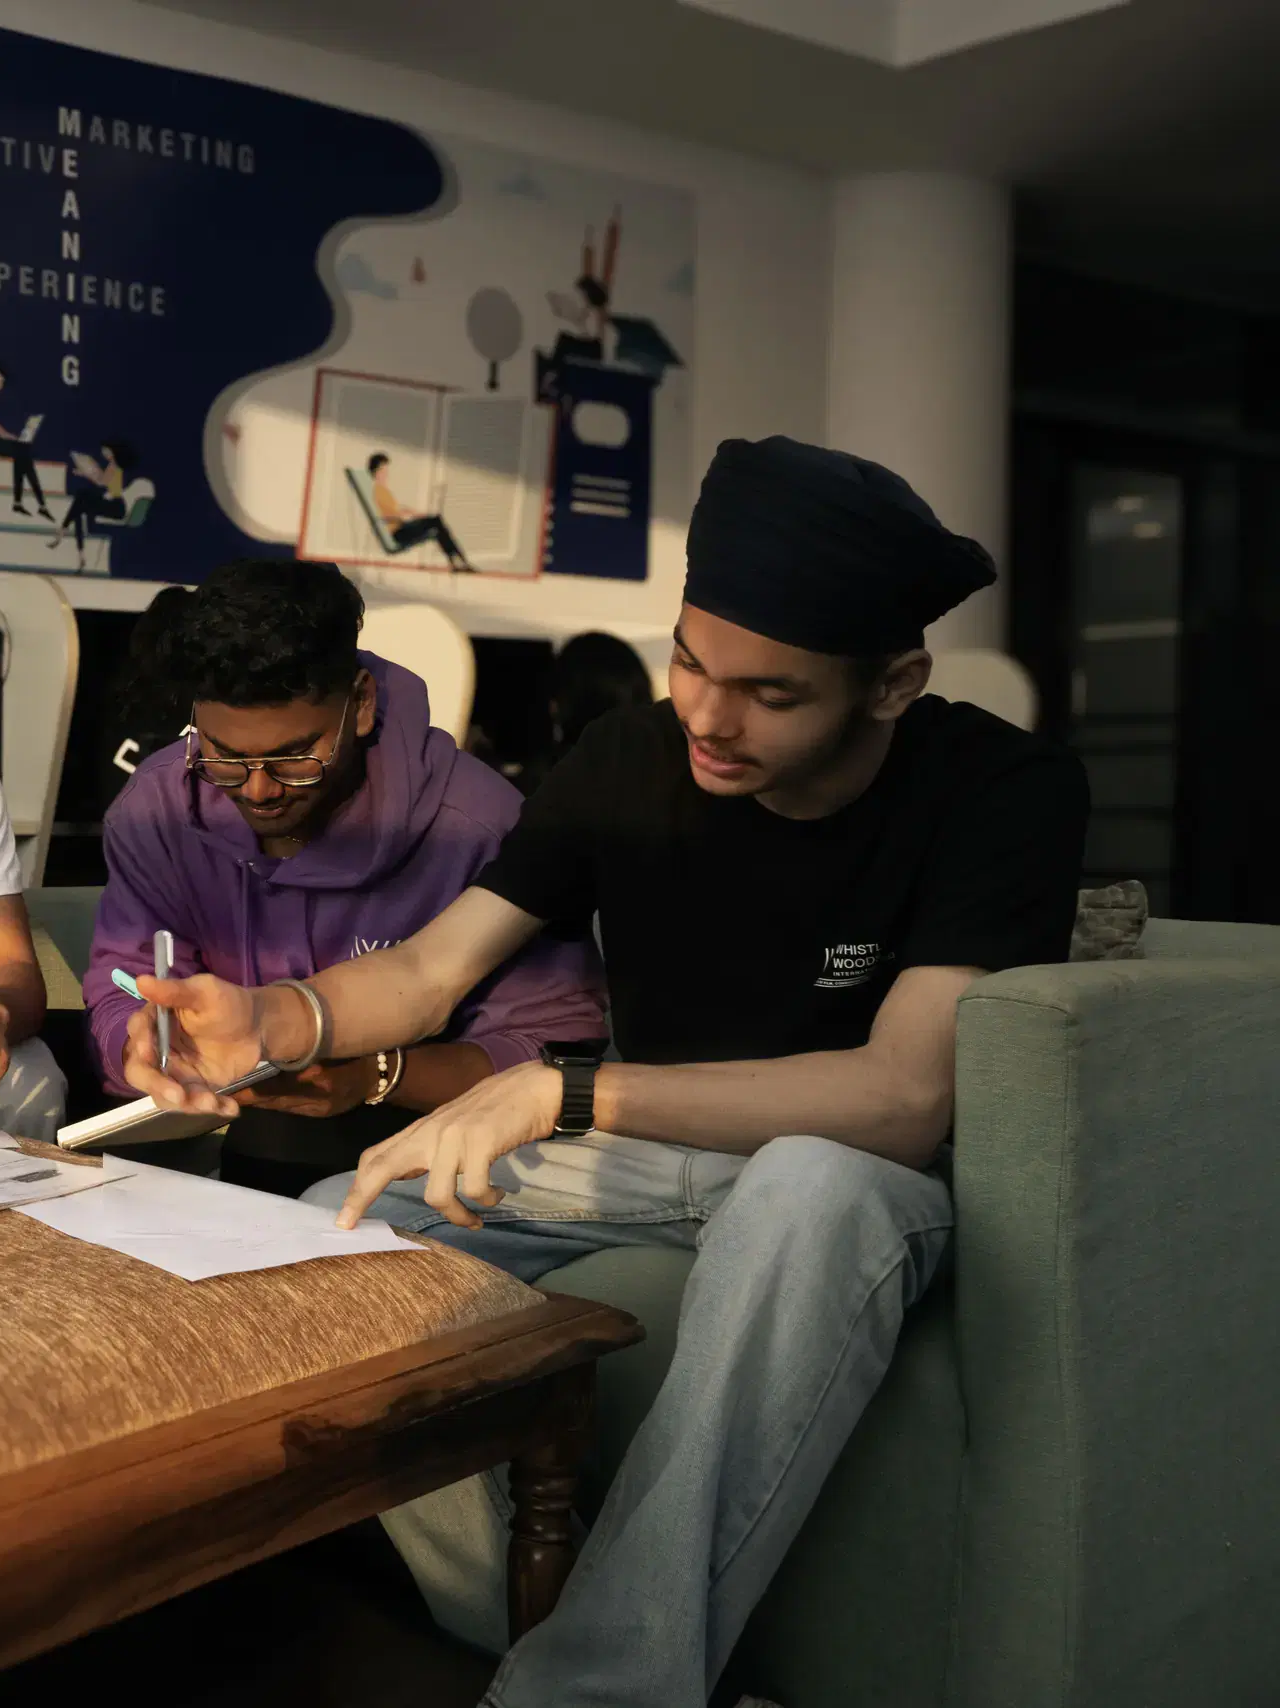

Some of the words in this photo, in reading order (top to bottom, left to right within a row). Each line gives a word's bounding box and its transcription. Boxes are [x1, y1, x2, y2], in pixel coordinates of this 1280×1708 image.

[58, 106, 256, 174] MARKETING
[58, 106, 81, 386] MEANING
[833, 956, 876, 968] WOOD
[836, 943, 882, 955] WHISTL
